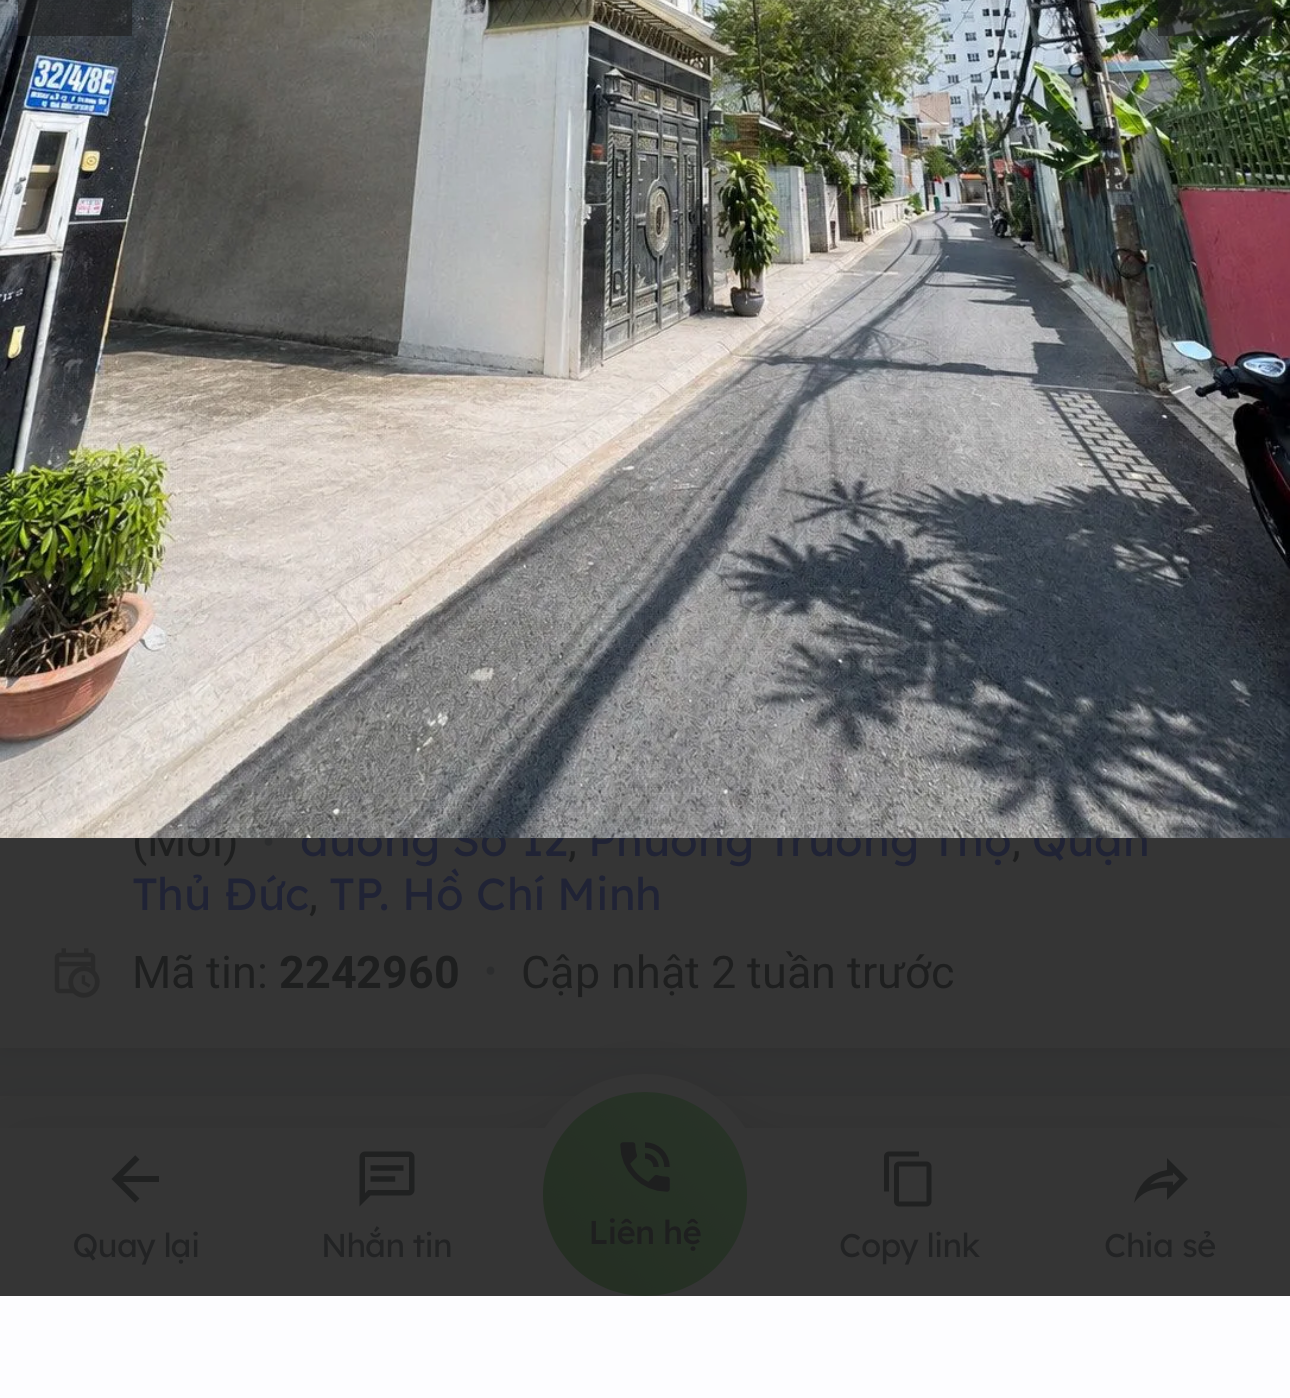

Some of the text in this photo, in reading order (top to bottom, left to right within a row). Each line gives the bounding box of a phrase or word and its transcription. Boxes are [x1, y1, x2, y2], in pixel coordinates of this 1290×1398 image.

[34, 59, 115, 95] 32/4/8E
[133, 869, 659, 916] Thủ Đức, TP. Hồ Chí Minh
[135, 951, 953, 997] Mã tin: 2242960 Cập nhật 2 tuần trước
[74, 1231, 198, 1265] Quay lại
[324, 1226, 451, 1257] Nhắn tin
[591, 1218, 701, 1251] Liên hệ
[840, 1231, 980, 1265] Copy link
[1105, 1231, 1215, 1258] Chia sẻ
